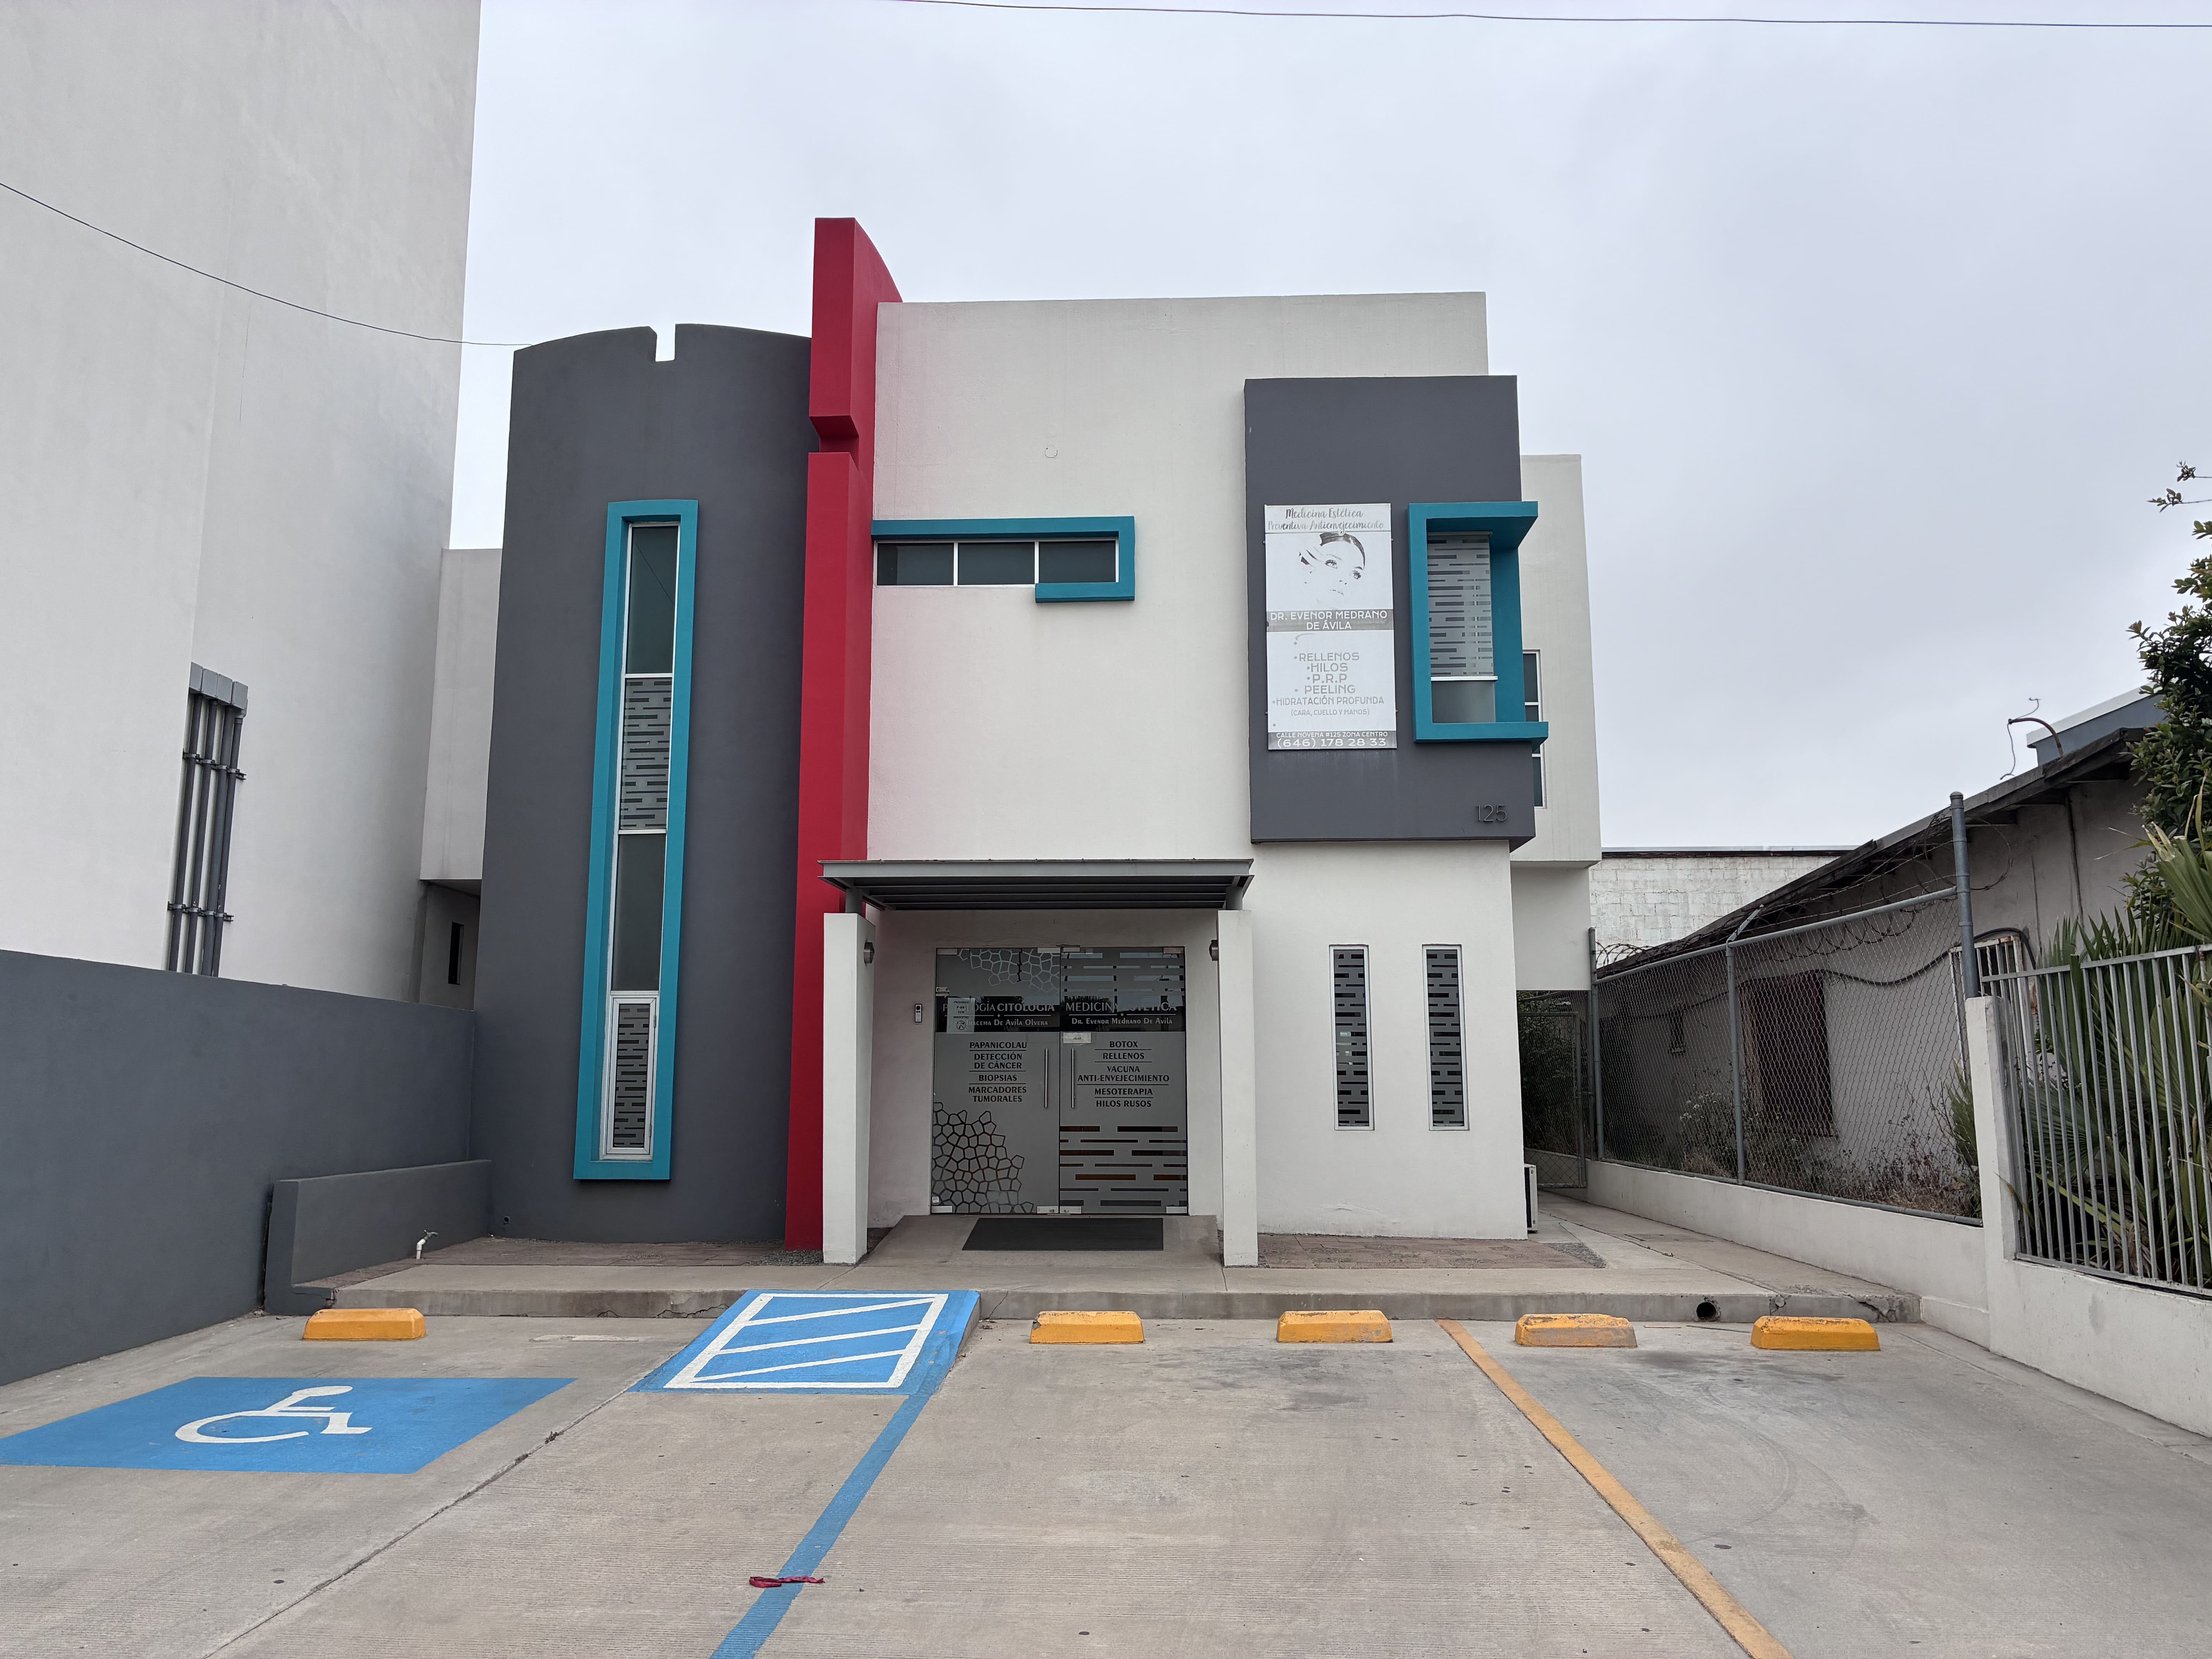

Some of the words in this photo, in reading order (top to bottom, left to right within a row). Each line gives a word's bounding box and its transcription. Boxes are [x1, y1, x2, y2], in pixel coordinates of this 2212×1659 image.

[1286, 508, 1328, 519] Medicina
[1329, 507, 1363, 518] Estética
[1268, 520, 1307, 531] Preventiva
[1309, 520, 1384, 536] Antienvejecimiento
[1271, 612, 1287, 620] DR.
[1291, 611, 1332, 620] EVENOR
[1336, 610, 1387, 619] MEDRANO
[1307, 622, 1319, 630] DE
[1322, 620, 1352, 630] ÁVILA
[1299, 652, 1359, 661] RELLENOS
[1311, 663, 1348, 672] HILOS
[1312, 673, 1347, 683] P.R.P
[1305, 685, 1355, 694] PEELING
[1276, 695, 1334, 706] HIDRATACIÓN
[1337, 696, 1384, 705] PROFUNDA
[1277, 738, 1316, 748] (646)
[1321, 738, 1343, 747] 178
[1348, 738, 1365, 746] 28
[1370, 738, 1386, 746] 33
[1476, 804, 1507, 821] 125
[974, 1052, 1022, 1060] DETECCIÓN
[988, 1060, 1022, 1069] CÁNCER
